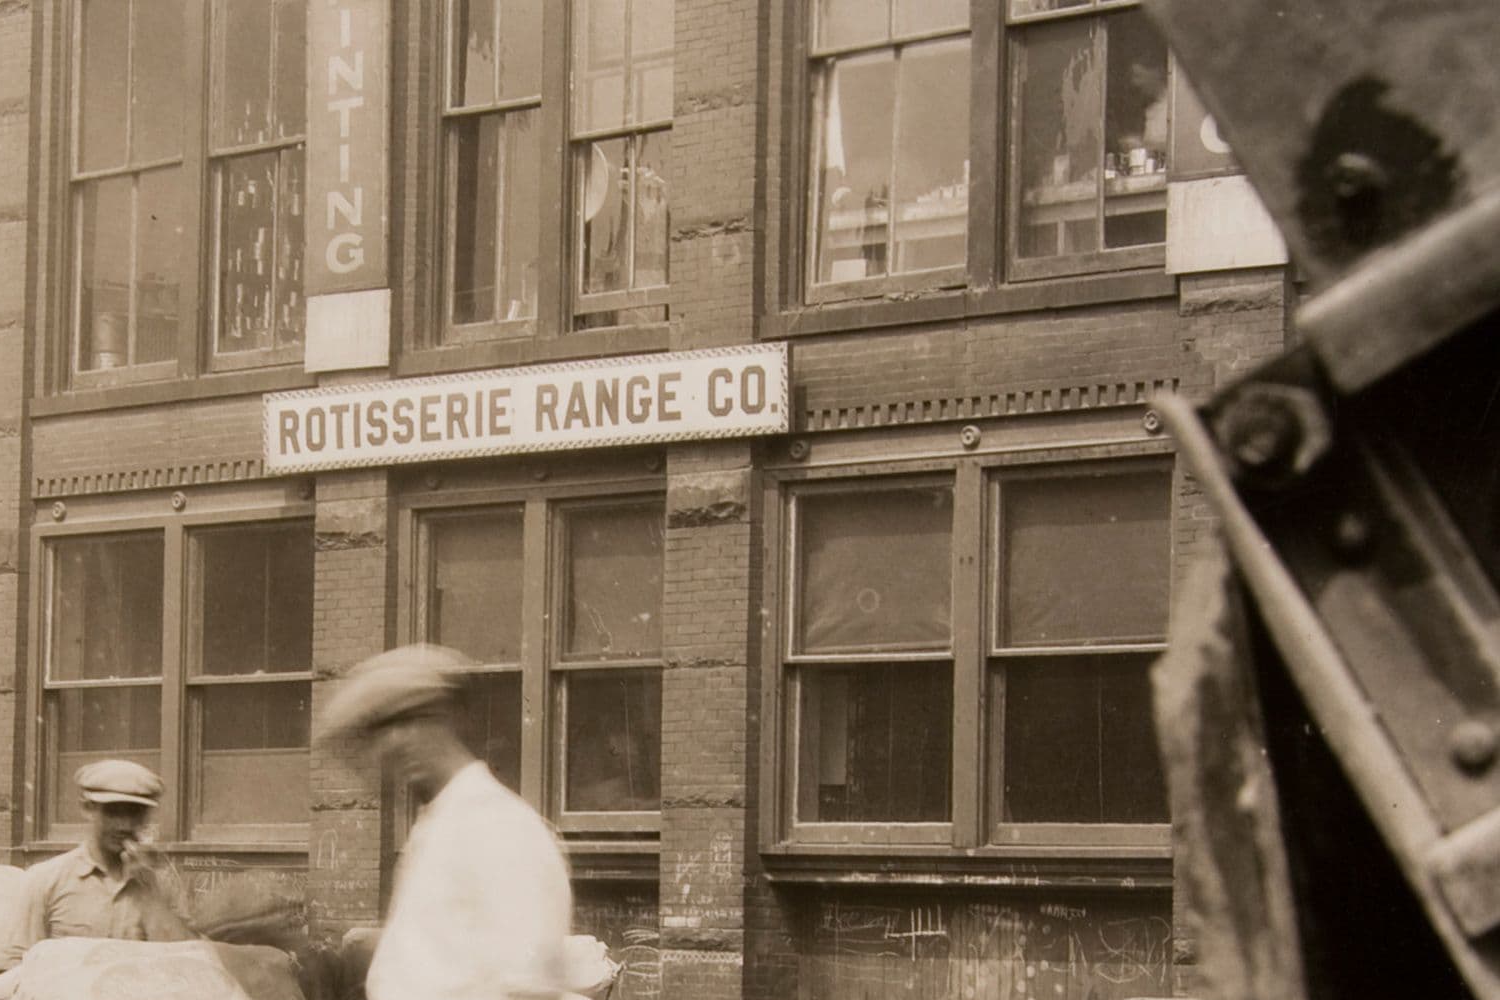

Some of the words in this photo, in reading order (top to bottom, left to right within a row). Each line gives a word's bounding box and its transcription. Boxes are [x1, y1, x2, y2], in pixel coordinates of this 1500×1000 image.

[326, 0, 365, 274] INTING
[279, 388, 513, 455] ROTISSERIE
[536, 372, 682, 432] RANGE
[707, 366, 779, 417] CO.
